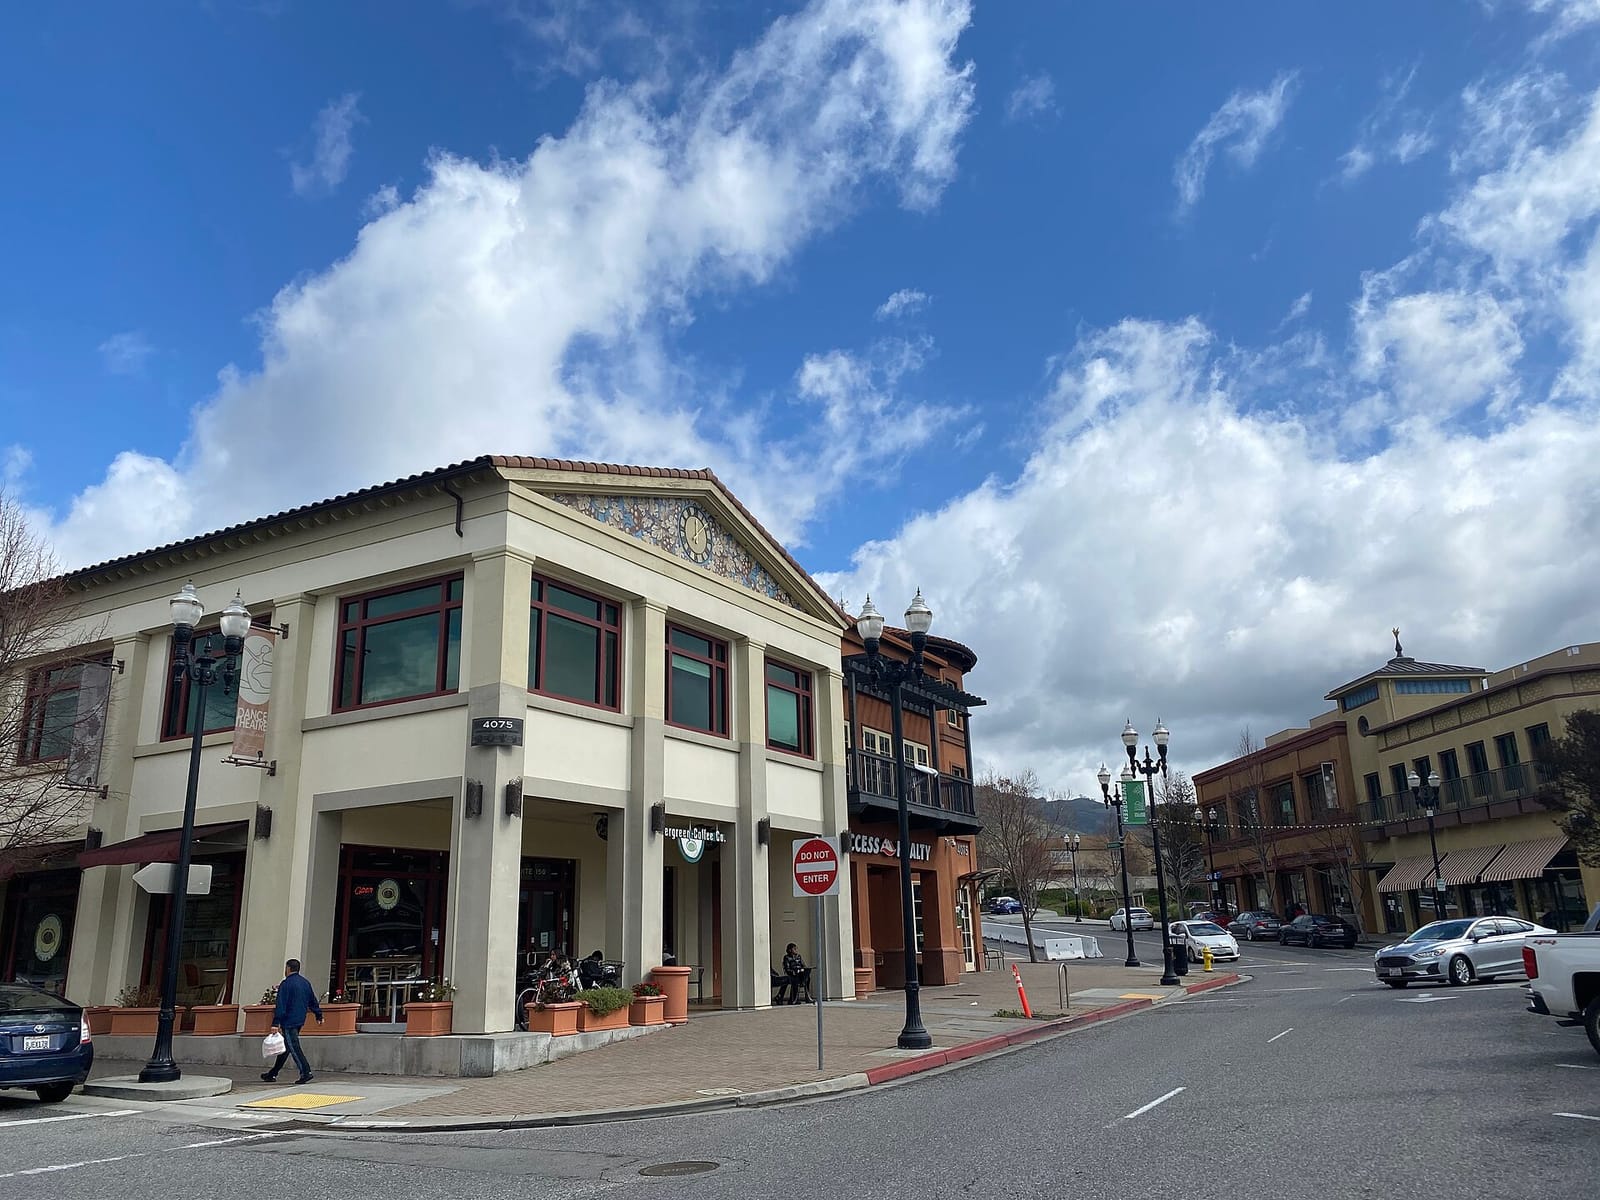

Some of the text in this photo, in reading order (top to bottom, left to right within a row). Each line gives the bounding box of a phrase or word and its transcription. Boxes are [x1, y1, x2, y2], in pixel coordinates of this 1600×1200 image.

[237, 707, 268, 720] DANCE
[235, 717, 268, 731] THEATRE
[482, 720, 513, 729] 4075
[1121, 783, 1129, 823] EVERGREEN
[664, 827, 691, 840] ergreen
[800, 850, 830, 861] DO NOT
[803, 874, 829, 884] ENTER
